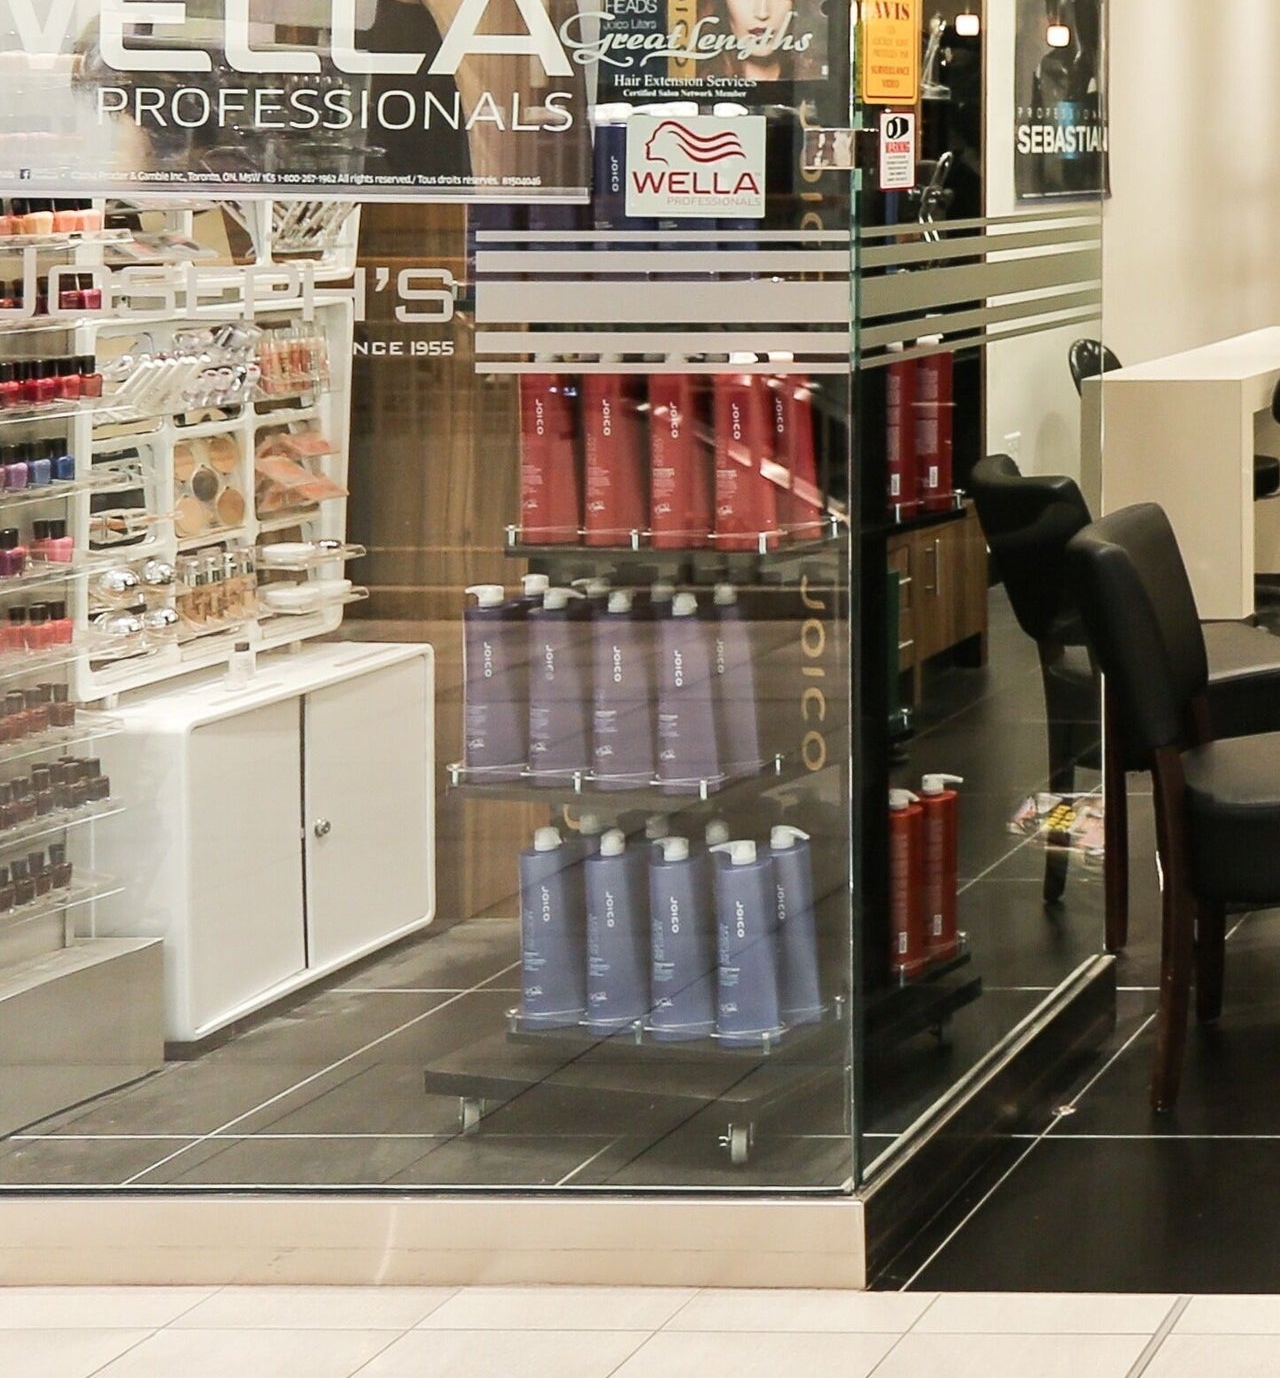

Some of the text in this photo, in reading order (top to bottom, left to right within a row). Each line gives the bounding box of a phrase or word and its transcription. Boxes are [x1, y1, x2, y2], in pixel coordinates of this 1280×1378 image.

[871, 0, 910, 21] AVIS
[557, 11, 683, 67] Great
[614, 74, 757, 88] Hair Extension Services
[623, 89, 747, 97] Certified Salon Network Member
[97, 87, 574, 132] PROFESSIONALS
[1017, 124, 1108, 154] SEBASTIAN
[138, 172, 169, 182] Gamble
[338, 174, 349, 183] All
[350, 174, 373, 186] rights
[418, 174, 436, 184] Tous
[437, 174, 461, 184] droits
[611, 156, 619, 192] JOICO
[632, 171, 760, 194] WELLA
[667, 196, 762, 206] PROFESSIONALS
[0, 246, 455, 322] JOSEPH'S
[353, 341, 455, 356] NCE 1955
[535, 399, 545, 435] JOICO
[602, 399, 611, 436] JOICO
[670, 402, 679, 438] JOICO
[732, 403, 741, 440] JOICO
[775, 398, 784, 433] JOICO
[483, 642, 492, 677] JOICO
[613, 646, 622, 683] JOICO
[674, 650, 683, 687] JOICO
[802, 575, 826, 772] JOICO
[541, 886, 550, 922] JOICO
[605, 891, 615, 928] JOICO
[670, 896, 679, 933] JOICO
[736, 901, 745, 938] JOICO
[776, 884, 786, 920] JOICO
